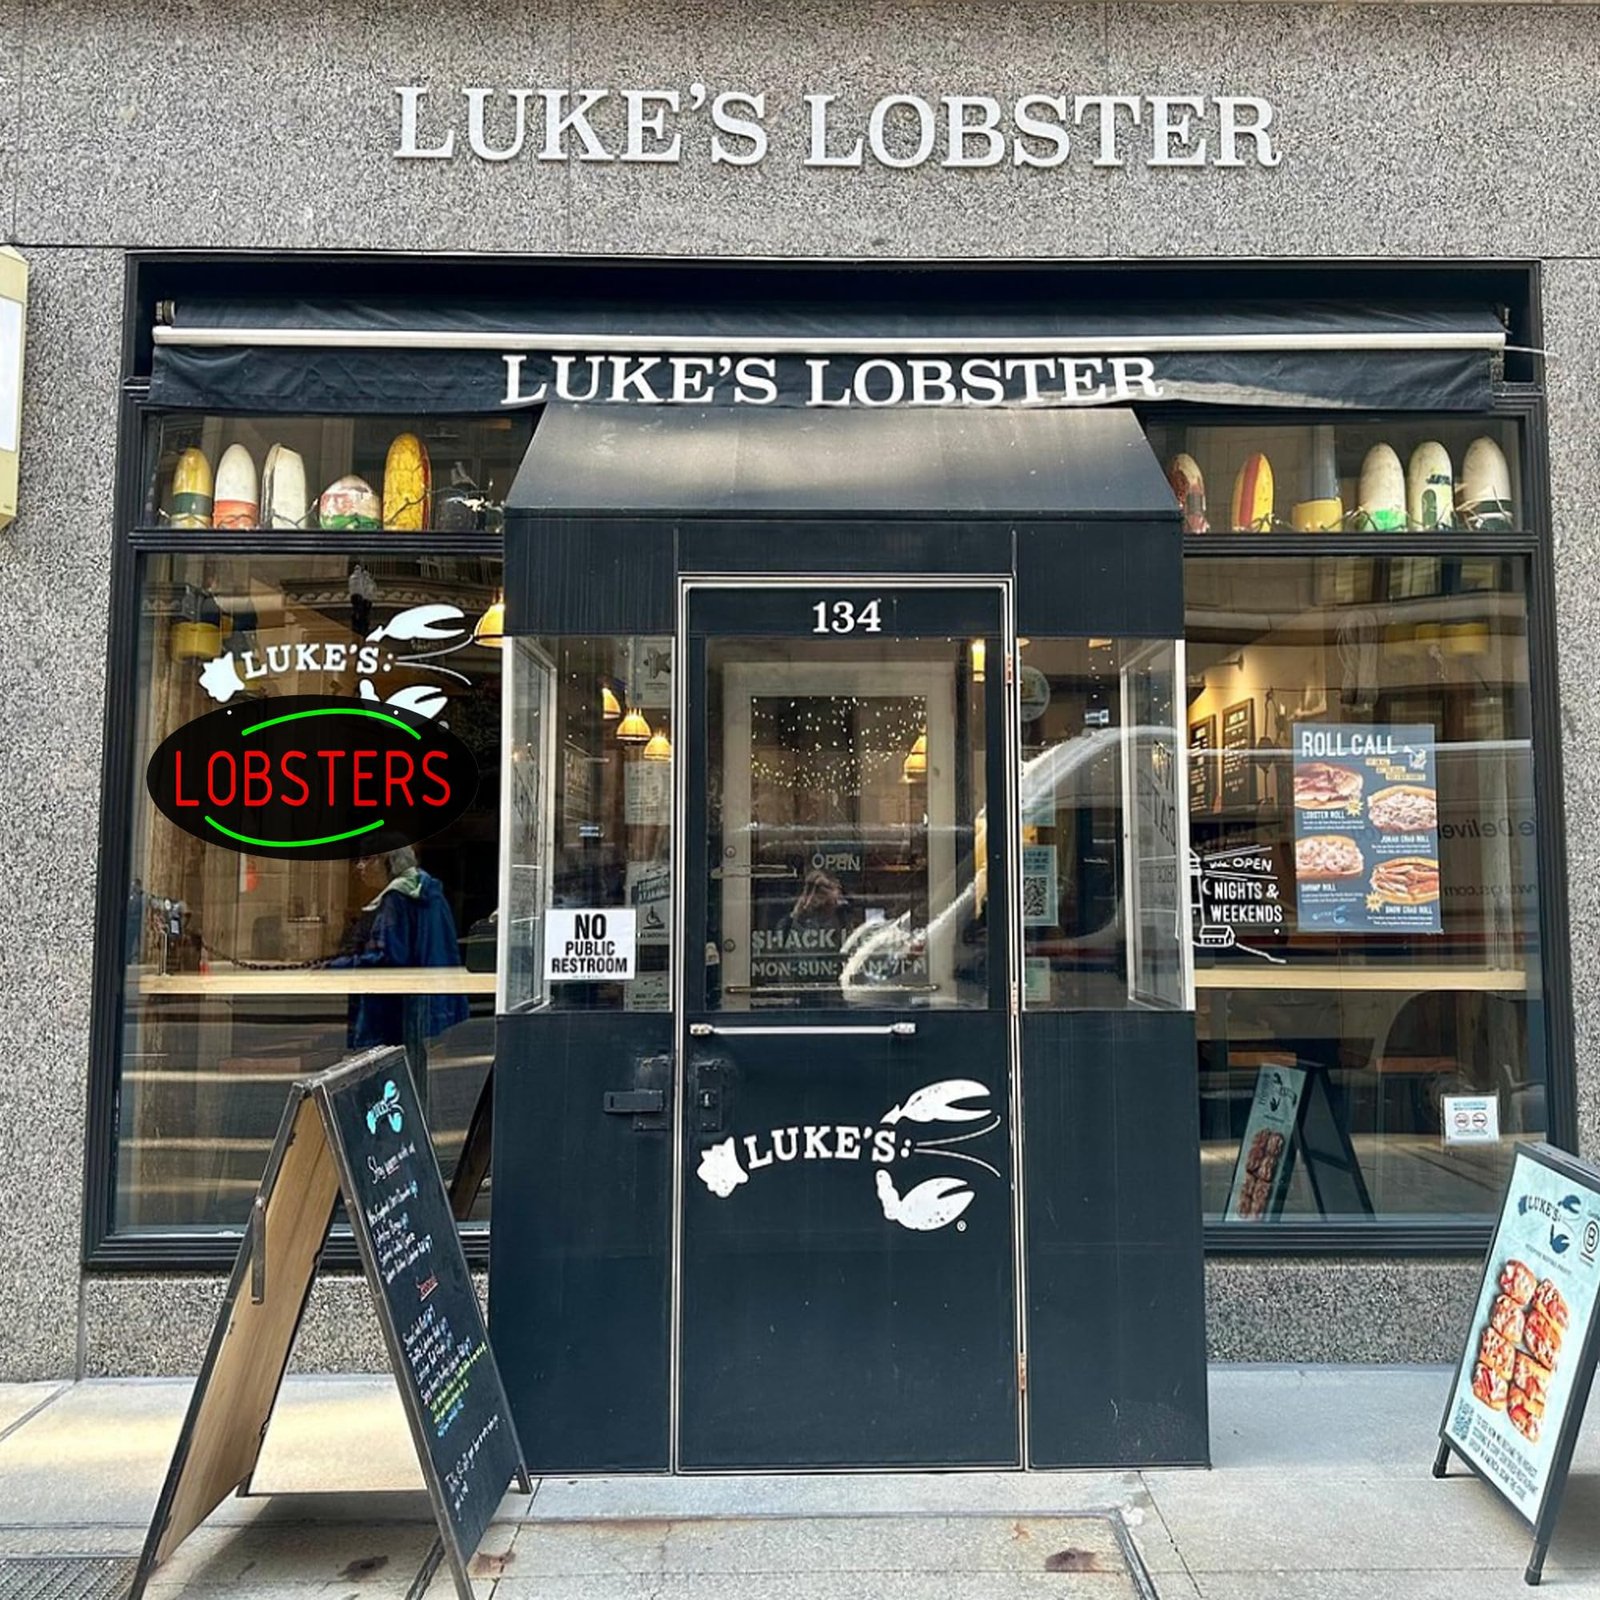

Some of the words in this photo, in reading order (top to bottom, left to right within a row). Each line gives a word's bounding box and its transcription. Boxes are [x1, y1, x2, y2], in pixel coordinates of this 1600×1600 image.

[393, 83, 768, 167] LUKE'S
[803, 94, 1283, 168] LOBSTER
[500, 354, 778, 405] LUKE'S
[805, 356, 1164, 407] LOBSTER
[812, 601, 881, 633] 134
[1302, 731, 1347, 757] ROLL
[1351, 733, 1397, 755] CALL
[175, 751, 451, 807] LOBSTERS
[811, 853, 861, 872] OPEN
[1232, 857, 1272, 873] OPEN
[1214, 881, 1262, 900] NIGHTS
[1266, 883, 1279, 899] &
[1210, 904, 1283, 922] WEEKENDS
[575, 913, 607, 940] NO
[565, 940, 615, 956] PUBLIC
[751, 928, 836, 950] SHACK
[552, 957, 628, 973] RESTROOM
